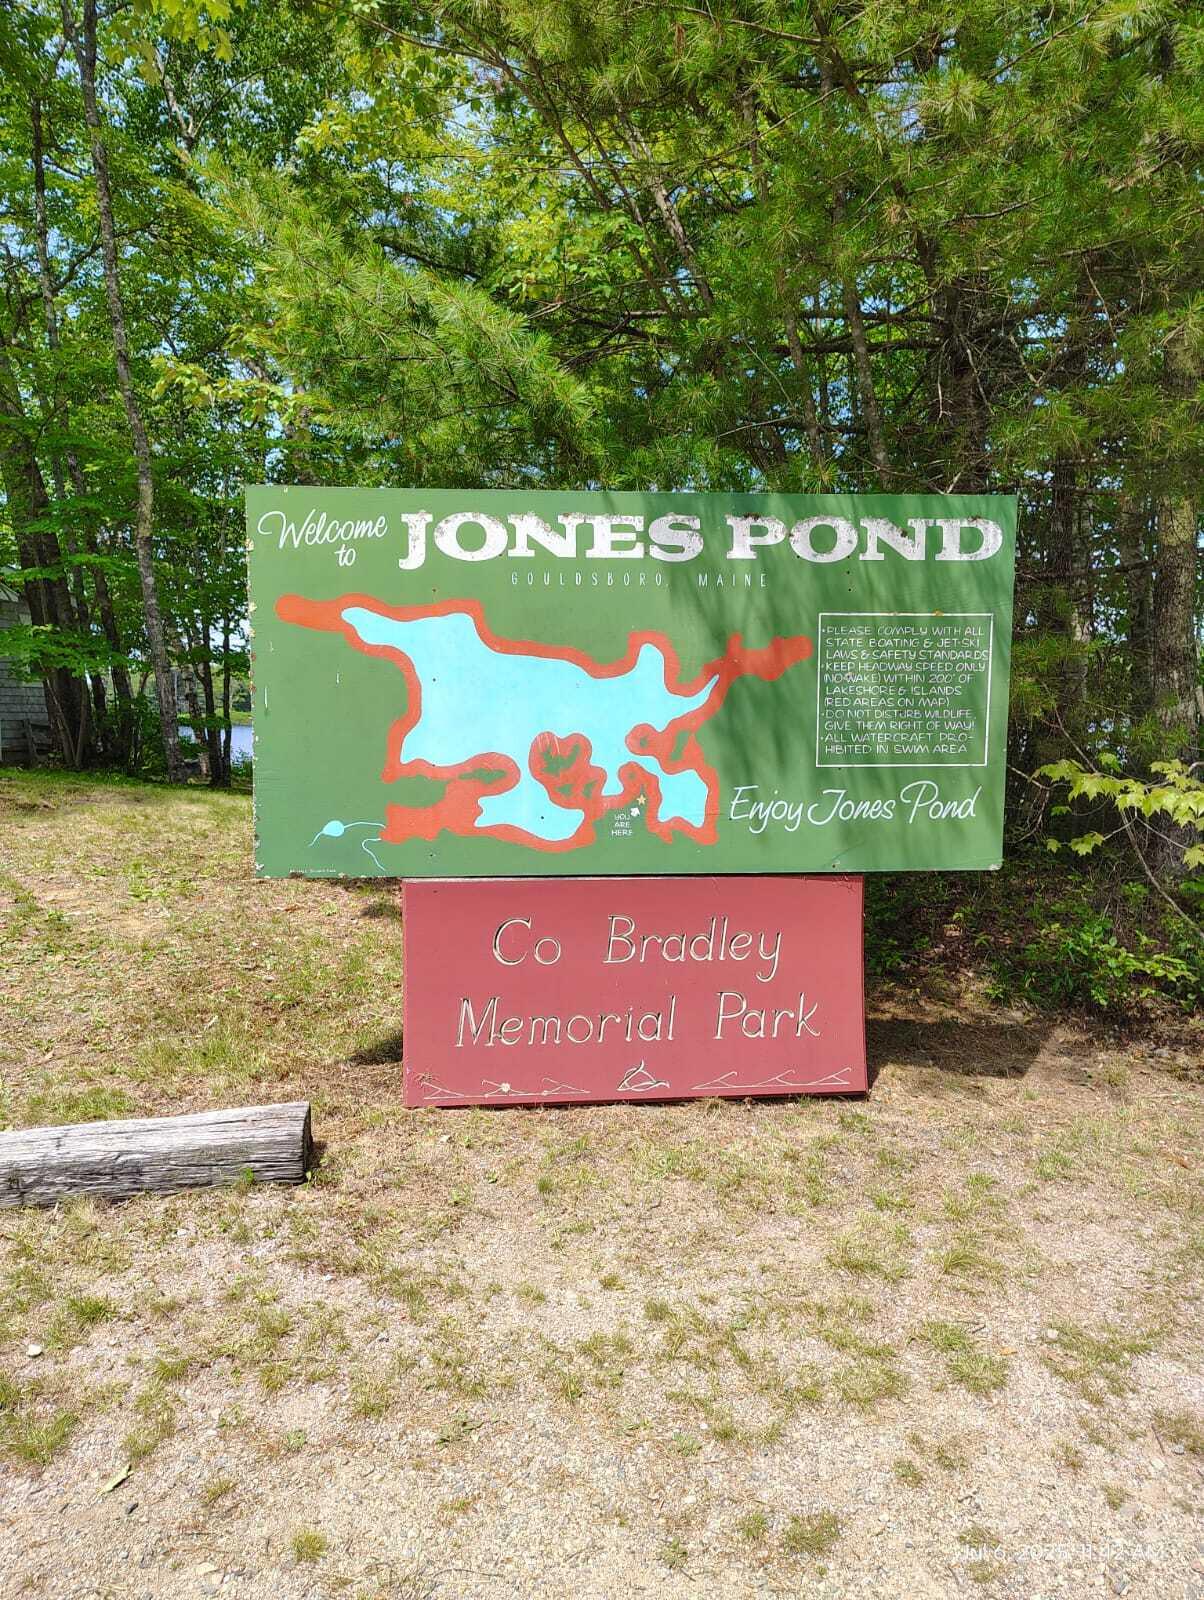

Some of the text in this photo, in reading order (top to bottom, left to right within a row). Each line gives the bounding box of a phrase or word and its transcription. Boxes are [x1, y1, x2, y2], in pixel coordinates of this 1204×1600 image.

[257, 508, 388, 549] Welcome
[399, 510, 1004, 570] JONES POND
[334, 543, 357, 567] to
[698, 572, 768, 588] MAINE
[826, 626, 984, 636] PLEASE COMPLY WITH ALL
[825, 638, 863, 648] STATE
[869, 638, 919, 648] BOATING
[923, 639, 934, 648] &
[825, 650, 989, 660] LAWS & SAFETY STANDARDS
[825, 662, 986, 672] KEEP HEADWAY SPEED ONLY
[883, 674, 926, 683] WITHIN
[958, 674, 976, 683] OF
[825, 686, 962, 696] LAKESHORE & ISLANDS
[824, 697, 950, 707] (RED AREAS ON MAP)
[825, 710, 844, 719] DO
[847, 710, 871, 719] NOT
[874, 710, 923, 719] DISTURB
[824, 721, 976, 730] GIVE THEM RIGHT OF WAY!
[824, 732, 976, 743] ALL WATERCRAFT PRO-
[825, 744, 968, 754] HIBITED IN SWIM AREA
[729, 780, 983, 834] Enjoy Jones Pond
[614, 813, 631, 821] YOU
[611, 829, 633, 837] HERE
[491, 914, 783, 983] Co Bradley
[455, 990, 822, 1048] Memorial Park
